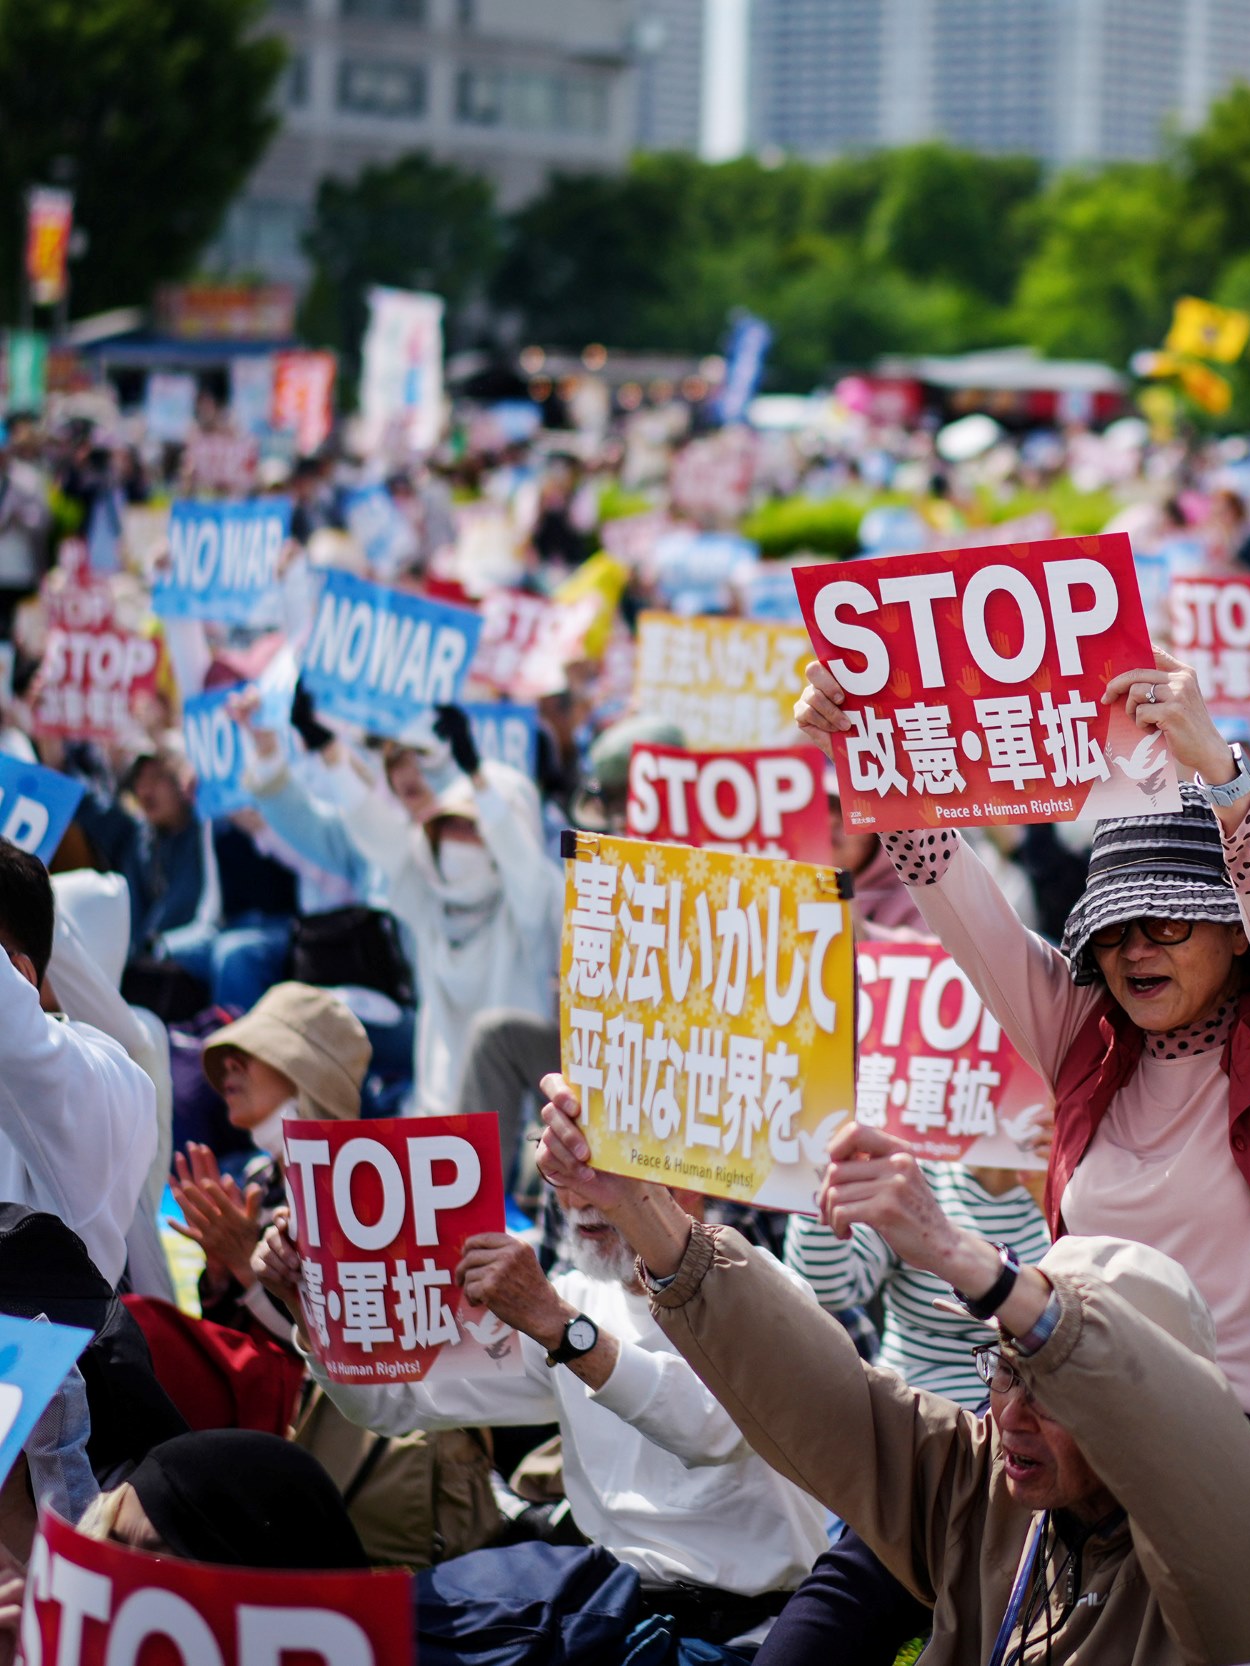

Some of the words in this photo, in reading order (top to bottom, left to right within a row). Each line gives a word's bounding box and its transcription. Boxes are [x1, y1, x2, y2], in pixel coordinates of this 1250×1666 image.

[165, 519, 219, 589] NO
[48, 629, 157, 688] STOP
[307, 593, 373, 683] NO
[367, 610, 467, 704] WAR
[813, 558, 1117, 696] STOP
[184, 706, 234, 779] NO
[845, 690, 1112, 798] 改憲・軍拡
[627, 749, 814, 840] STOP
[935, 805, 970, 819] Peace
[972, 804, 983, 817] &
[984, 801, 1029, 816] Human
[1030, 798, 1075, 817] Rights!
[568, 856, 843, 1034] 憲法いかして
[568, 1008, 801, 1164] 平和な世界を
[857, 1052, 1001, 1137] 憲・軍拡
[630, 1149, 661, 1169] Peace
[664, 1155, 672, 1171] &
[674, 1158, 713, 1180] Human
[716, 1165, 754, 1188] Rights!
[338, 1361, 373, 1376] Human
[375, 1359, 421, 1377] Rights!
[19, 1530, 376, 1666] ST
